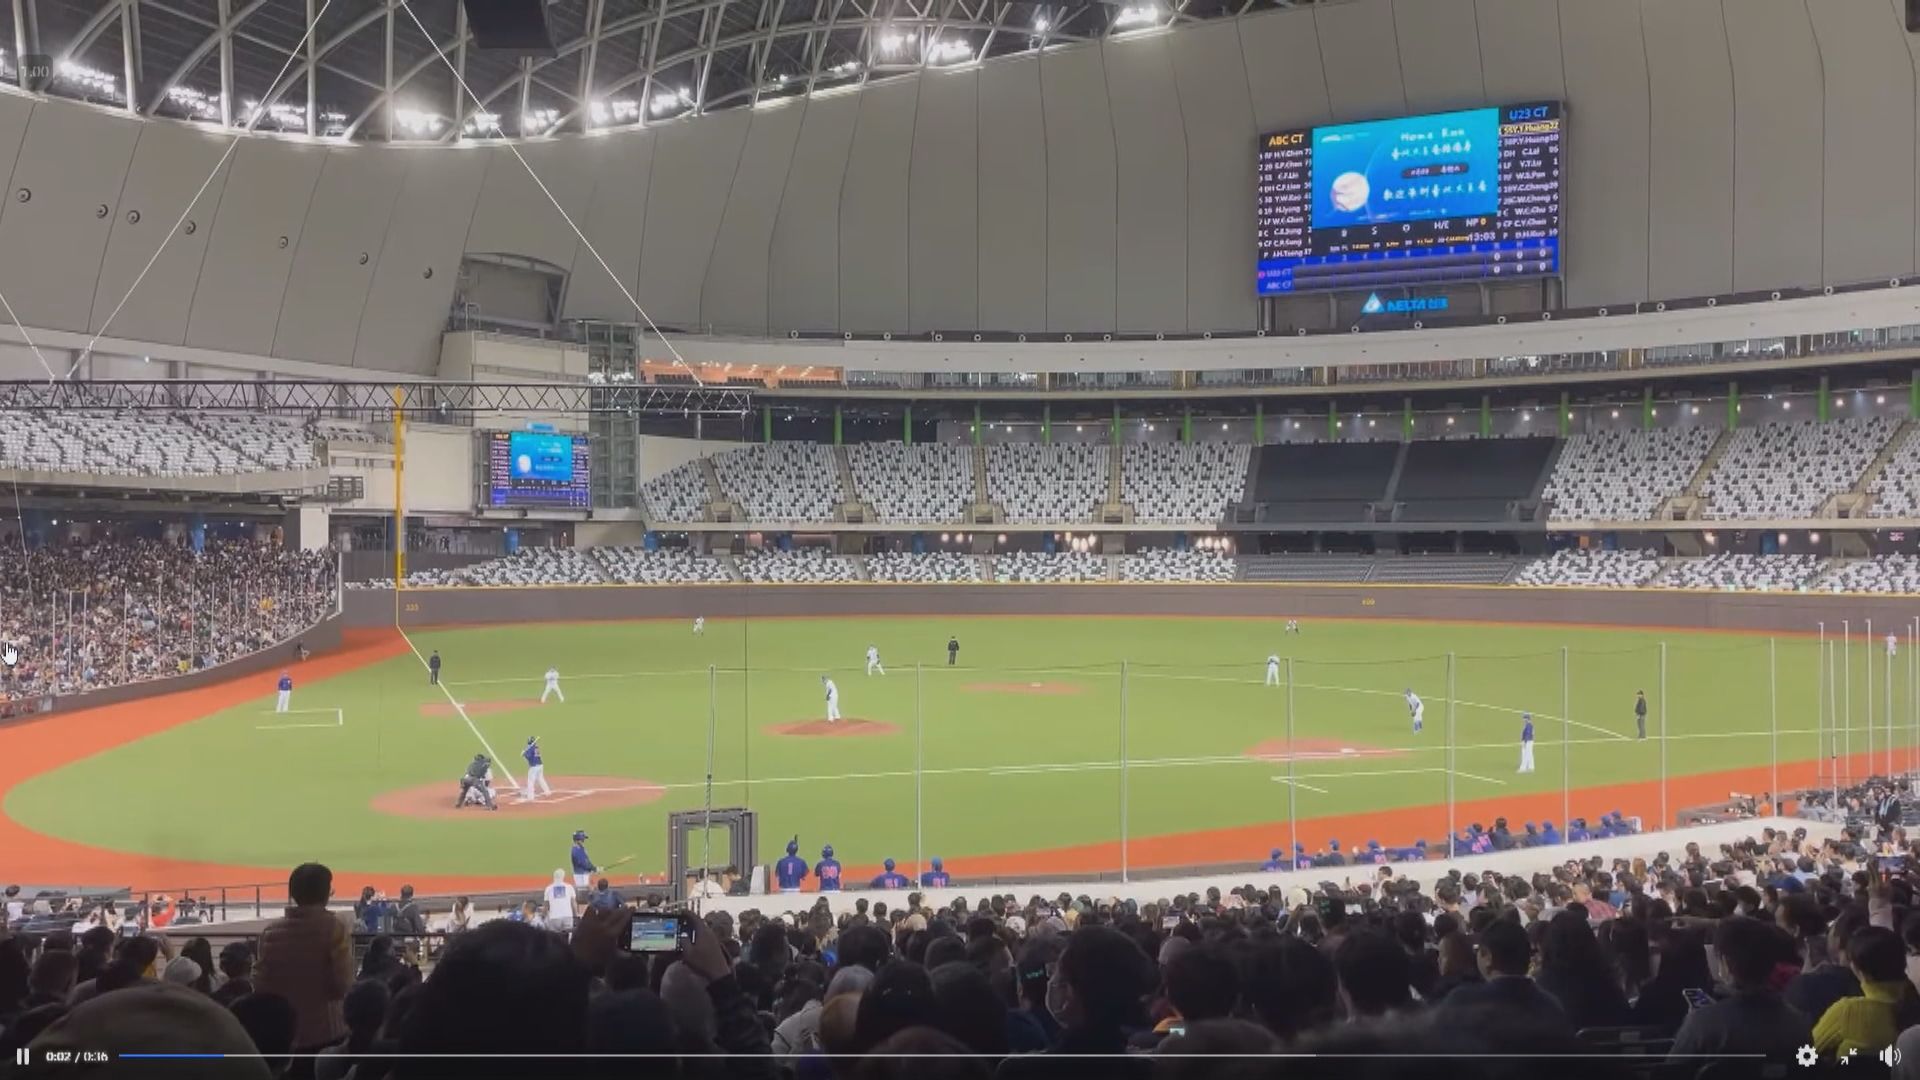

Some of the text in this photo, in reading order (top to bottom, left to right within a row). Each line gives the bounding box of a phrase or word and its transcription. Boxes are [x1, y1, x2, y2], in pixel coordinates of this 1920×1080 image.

[1509, 106, 1548, 120] U23 CT
[1268, 134, 1304, 147] ABC CT
[1372, 226, 1378, 235] S
[1434, 220, 1449, 229] H/E
[1466, 218, 1479, 227] NP
[1494, 252, 1500, 261] 0
[1517, 250, 1523, 259] 0
[1539, 248, 1546, 257] 0
[1516, 264, 1523, 272] 0
[1540, 262, 1546, 271] 0
[788, 862, 793, 875] 1
